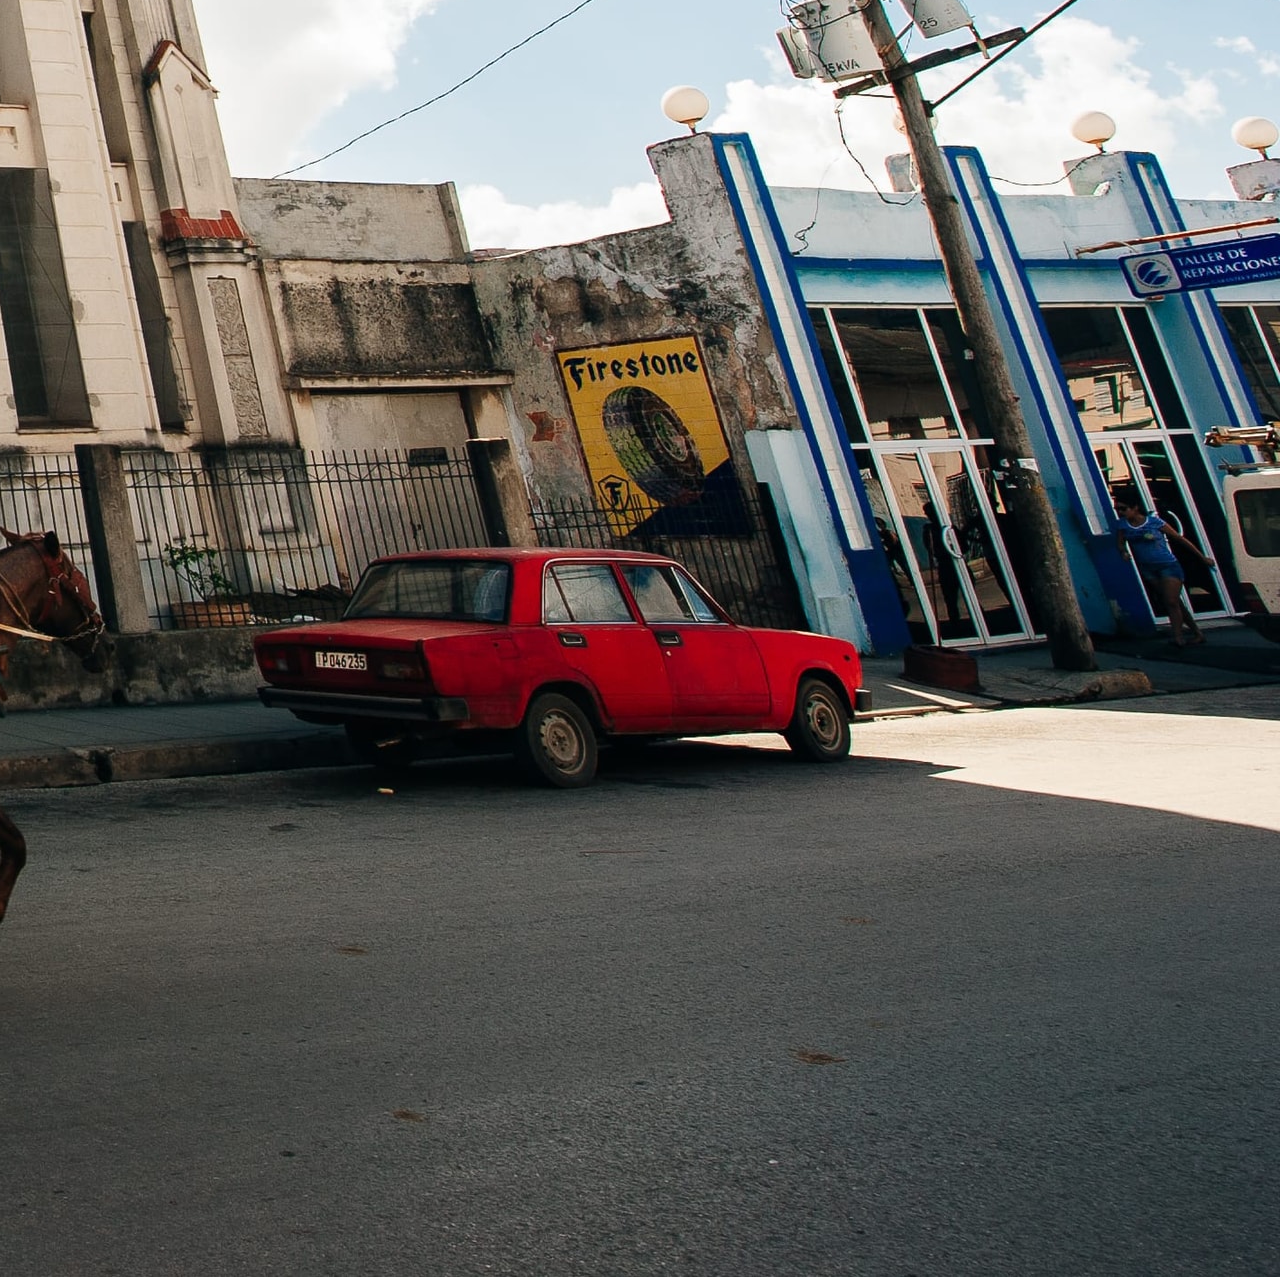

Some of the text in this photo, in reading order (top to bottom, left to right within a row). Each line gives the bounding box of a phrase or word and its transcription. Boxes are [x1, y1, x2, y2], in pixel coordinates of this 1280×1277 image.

[920, 16, 938, 30] 25
[1175, 248, 1248, 267] TALLER DE
[1181, 256, 1280, 279] REPARACIONE
[563, 351, 699, 392] Firestone
